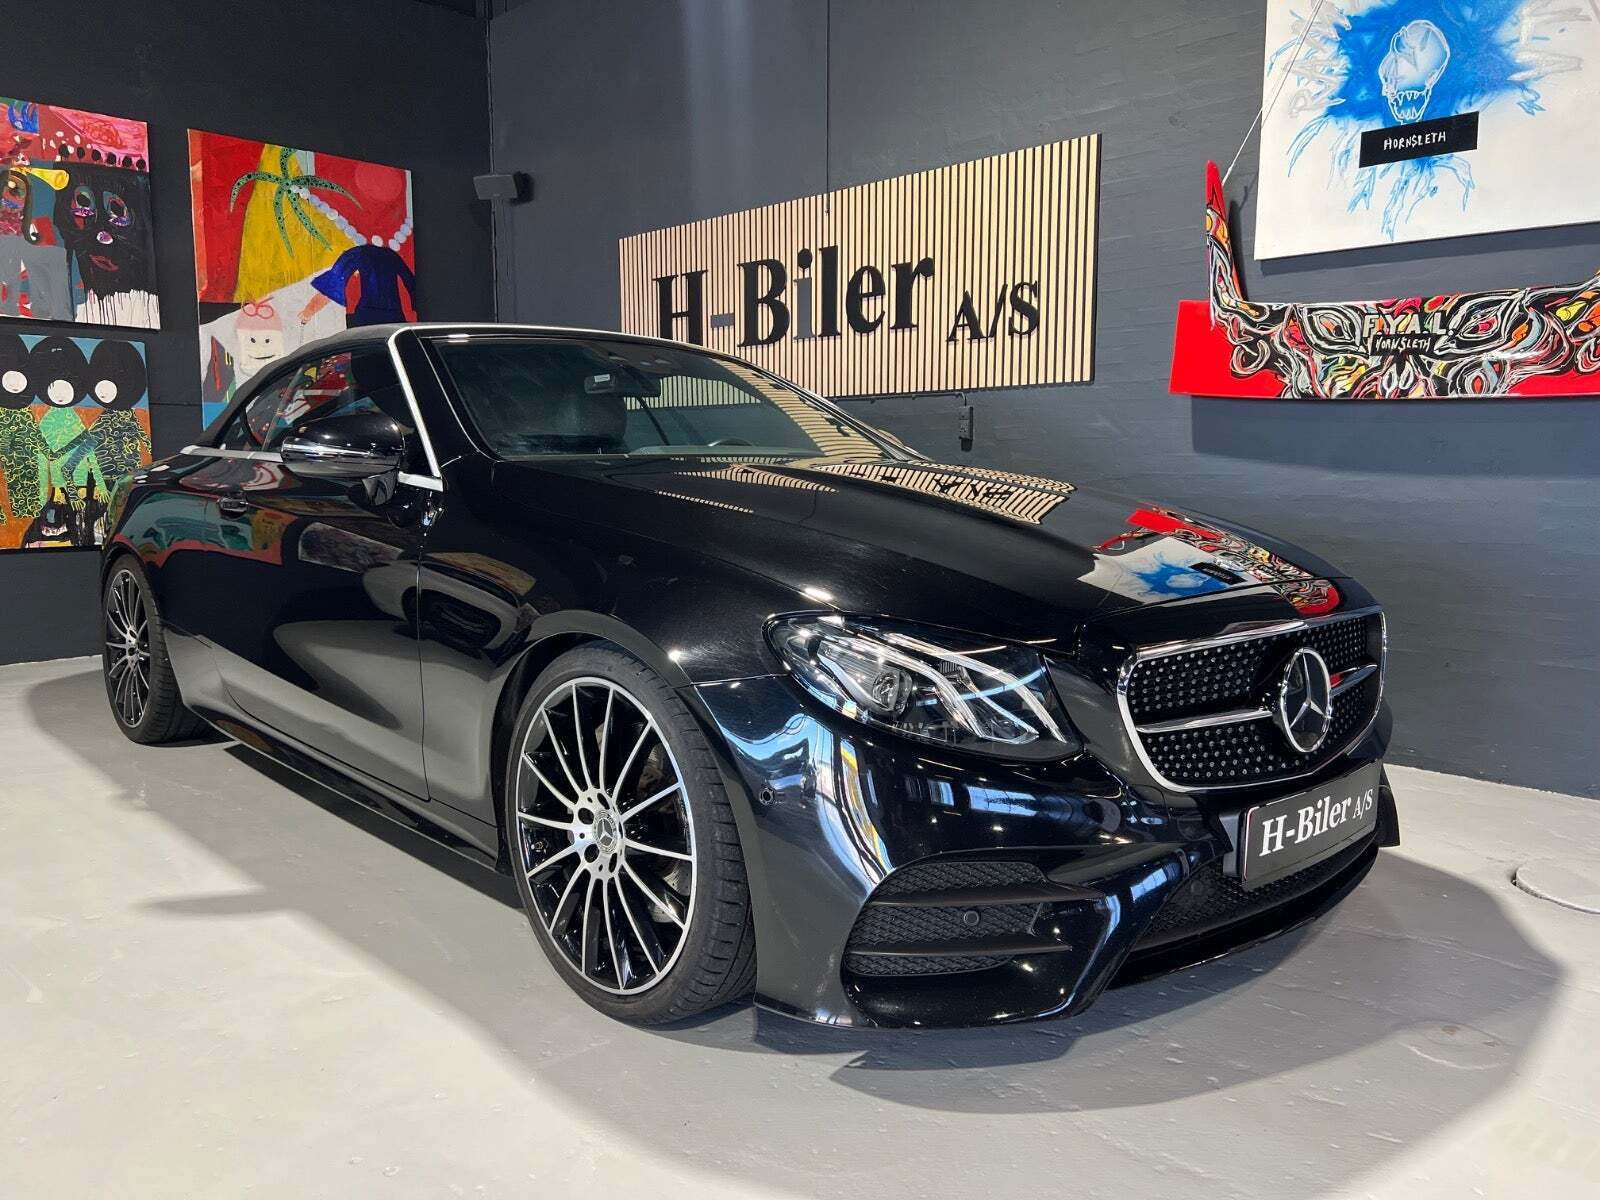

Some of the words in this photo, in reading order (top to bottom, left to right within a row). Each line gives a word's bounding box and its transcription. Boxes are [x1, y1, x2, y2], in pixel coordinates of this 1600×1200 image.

[651, 245, 935, 347] H-Biler
[946, 280, 1040, 342] A/S
[1259, 796, 1351, 857] H-Biler
[1352, 788, 1373, 820] A/S
